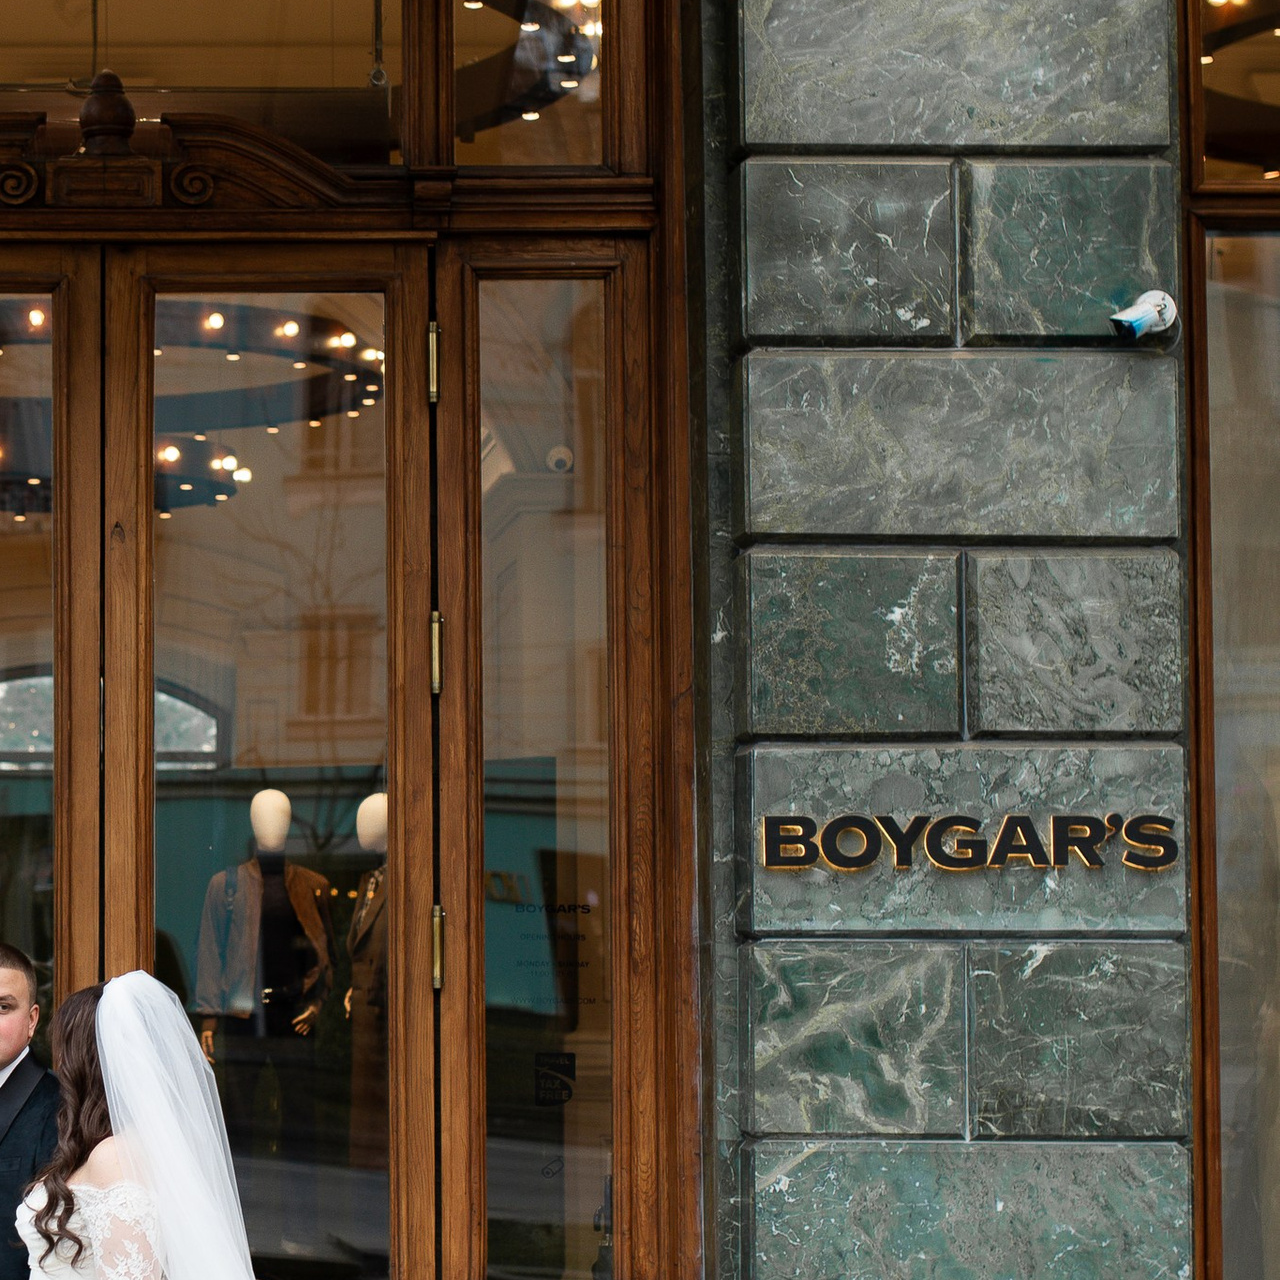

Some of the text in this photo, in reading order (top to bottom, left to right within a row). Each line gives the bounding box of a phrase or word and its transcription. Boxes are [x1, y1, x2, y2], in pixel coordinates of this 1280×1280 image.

[762, 812, 1180, 870] BOYGAR'S
[515, 903, 592, 915] BOYGAR'S
[519, 933, 555, 941] OPENIN
[538, 1079, 562, 1089] TAX
[538, 1091, 569, 1100] FREE
